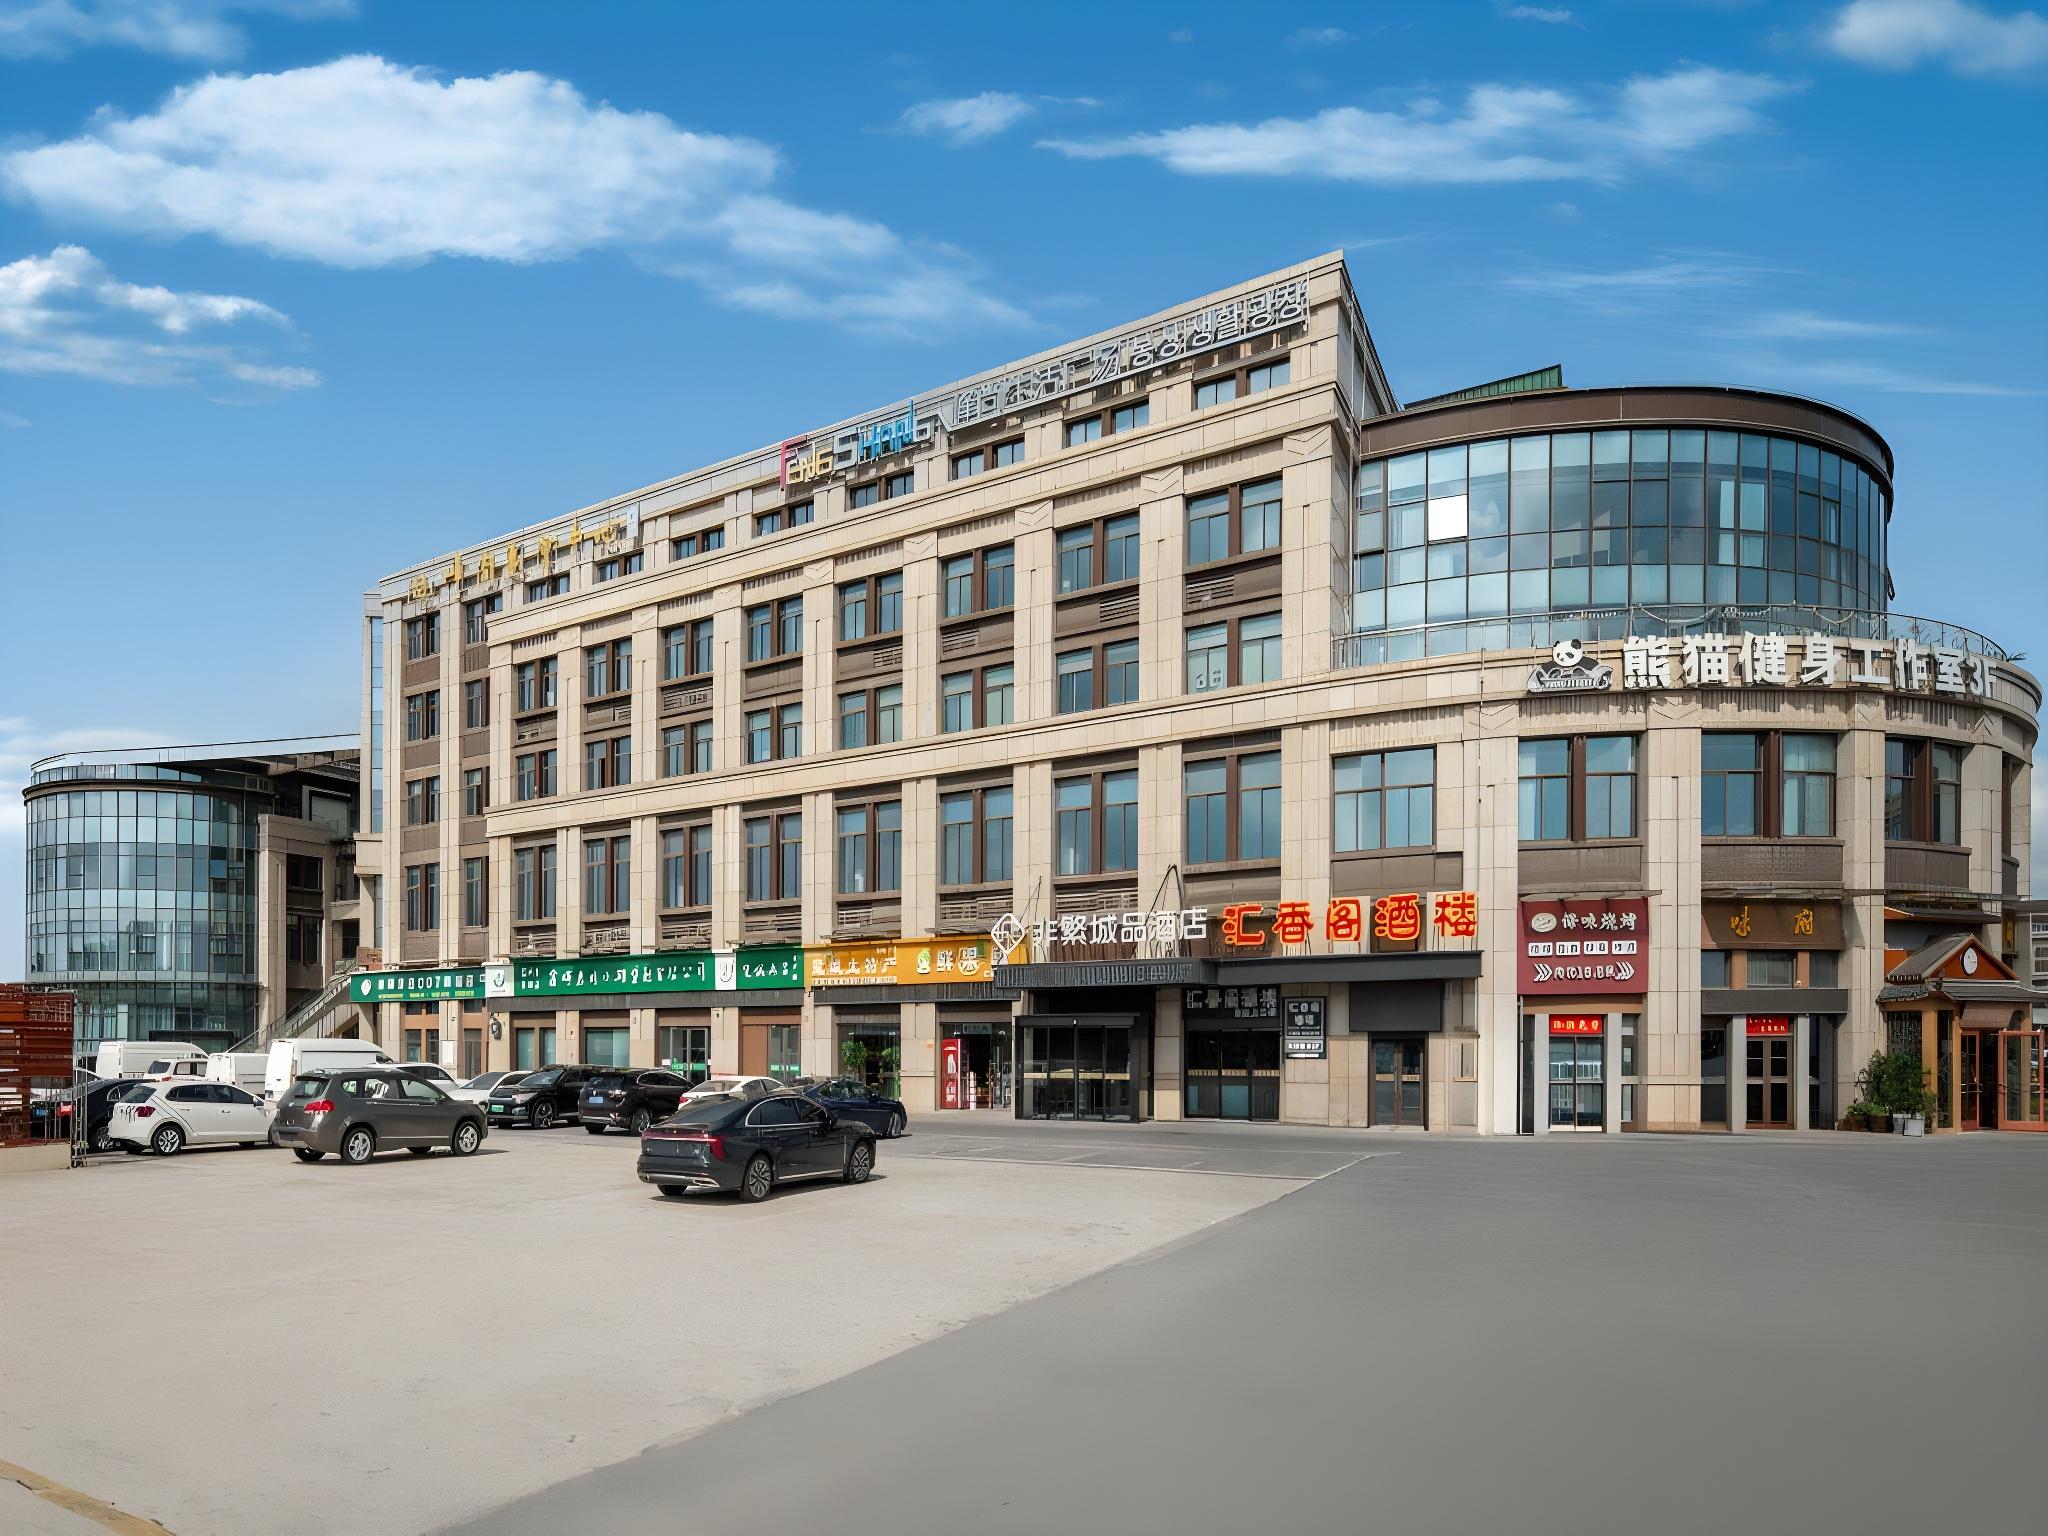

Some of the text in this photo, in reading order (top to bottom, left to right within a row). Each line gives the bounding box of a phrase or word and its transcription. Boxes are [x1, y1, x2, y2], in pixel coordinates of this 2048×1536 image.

[1221, 891, 1477, 947] 汇香阁酒楼
